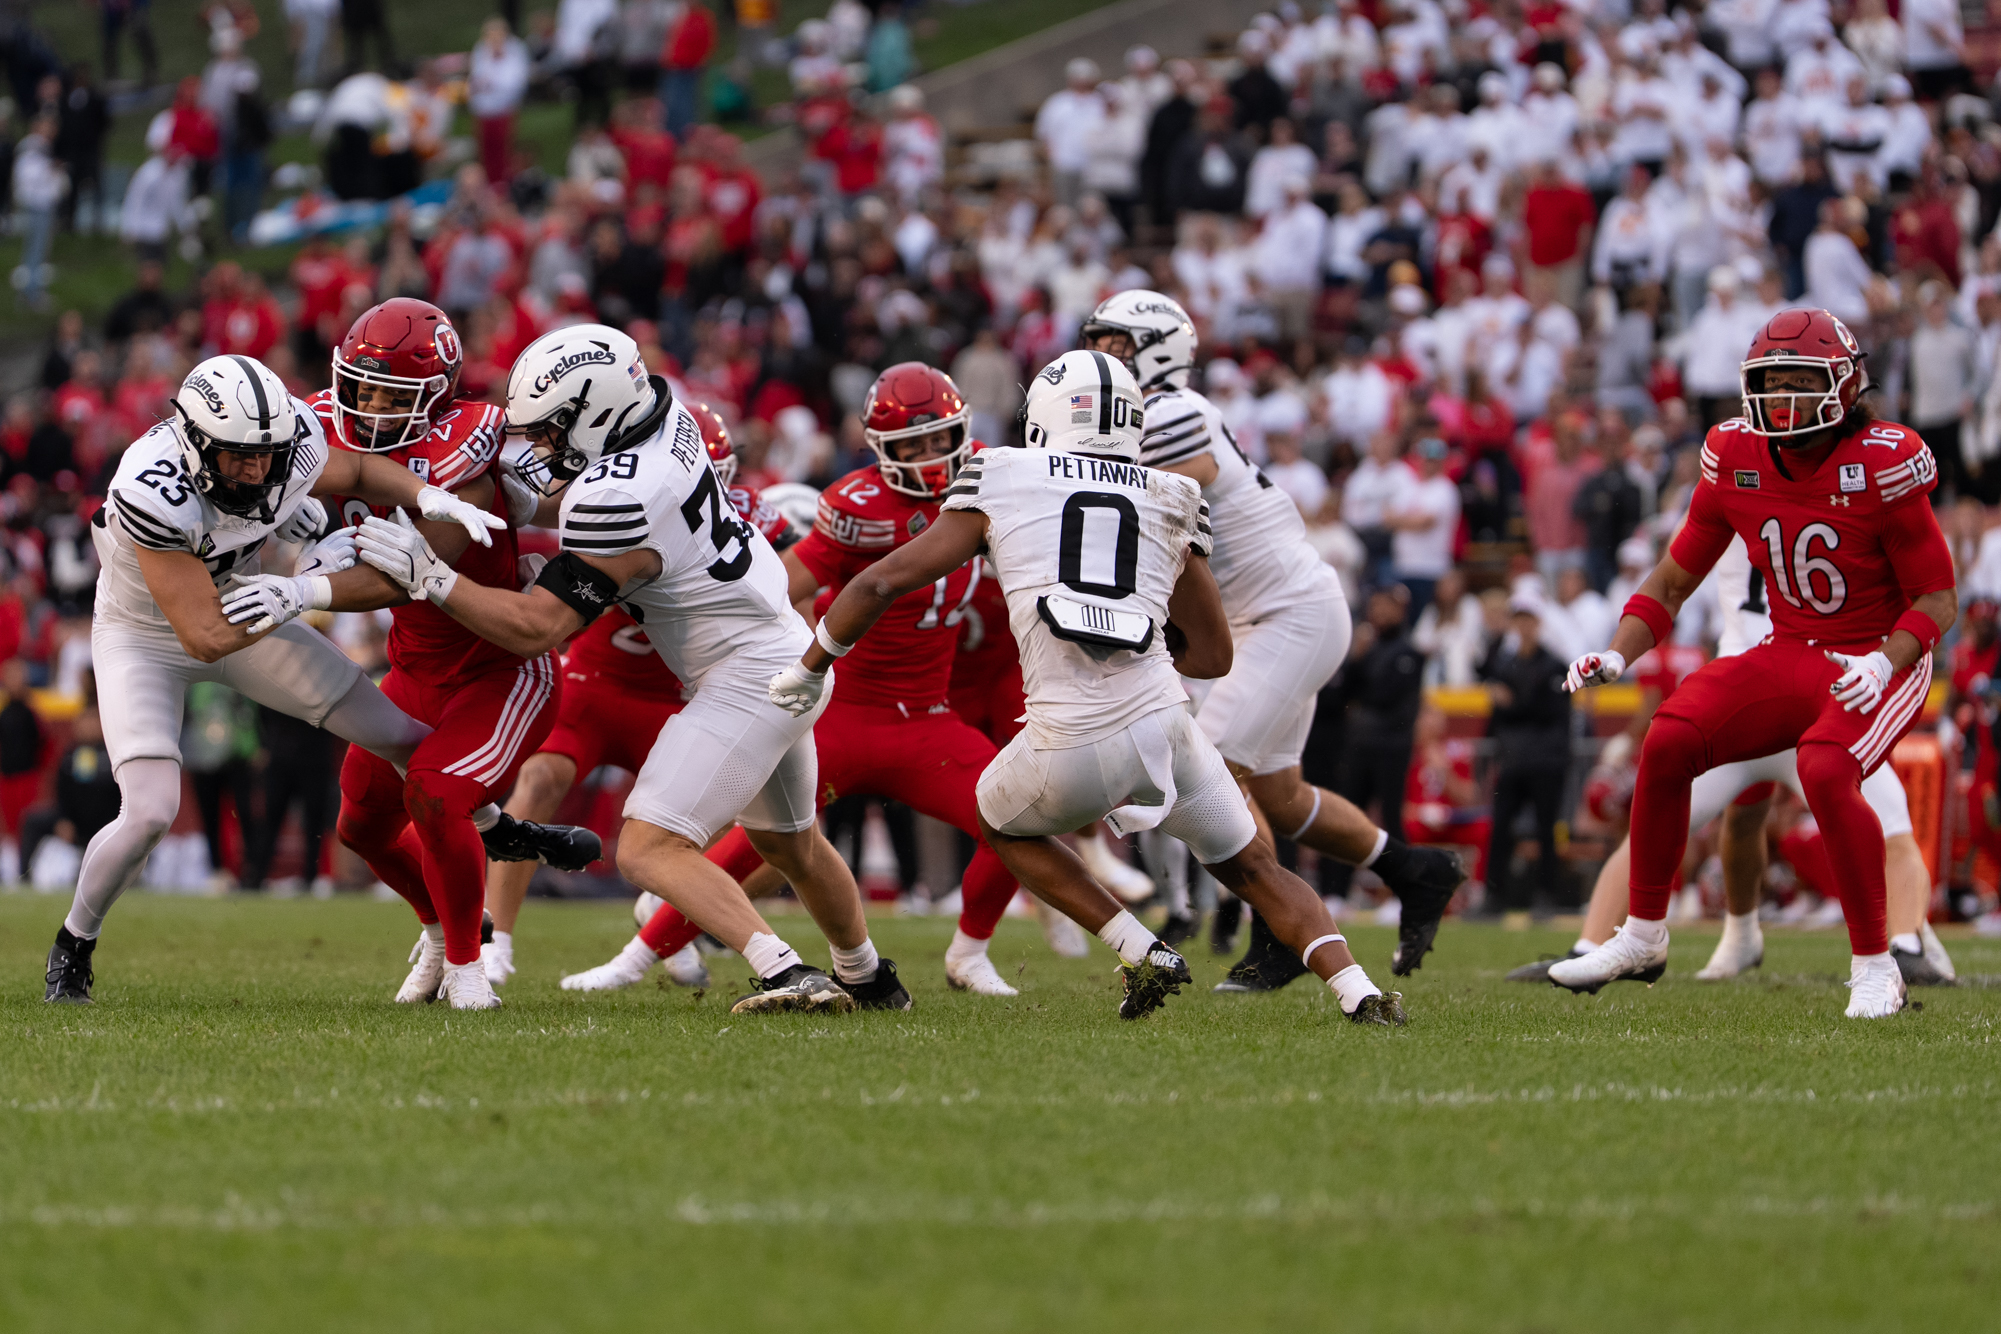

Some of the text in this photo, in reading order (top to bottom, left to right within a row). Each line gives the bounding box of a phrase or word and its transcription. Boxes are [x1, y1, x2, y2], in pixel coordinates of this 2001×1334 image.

[437, 330, 457, 361] U
[534, 350, 616, 392] Cyclones
[426, 408, 462, 443] 20
[1113, 396, 1126, 428] 0
[1862, 427, 1906, 450] 16
[135, 459, 197, 507] 23
[584, 453, 639, 484] 39
[1048, 455, 1148, 490] PETTAWAY
[838, 478, 880, 505] 12
[1058, 491, 1139, 600] 0
[1760, 517, 1847, 615] 16
[1150, 950, 1182, 969] NIKE
